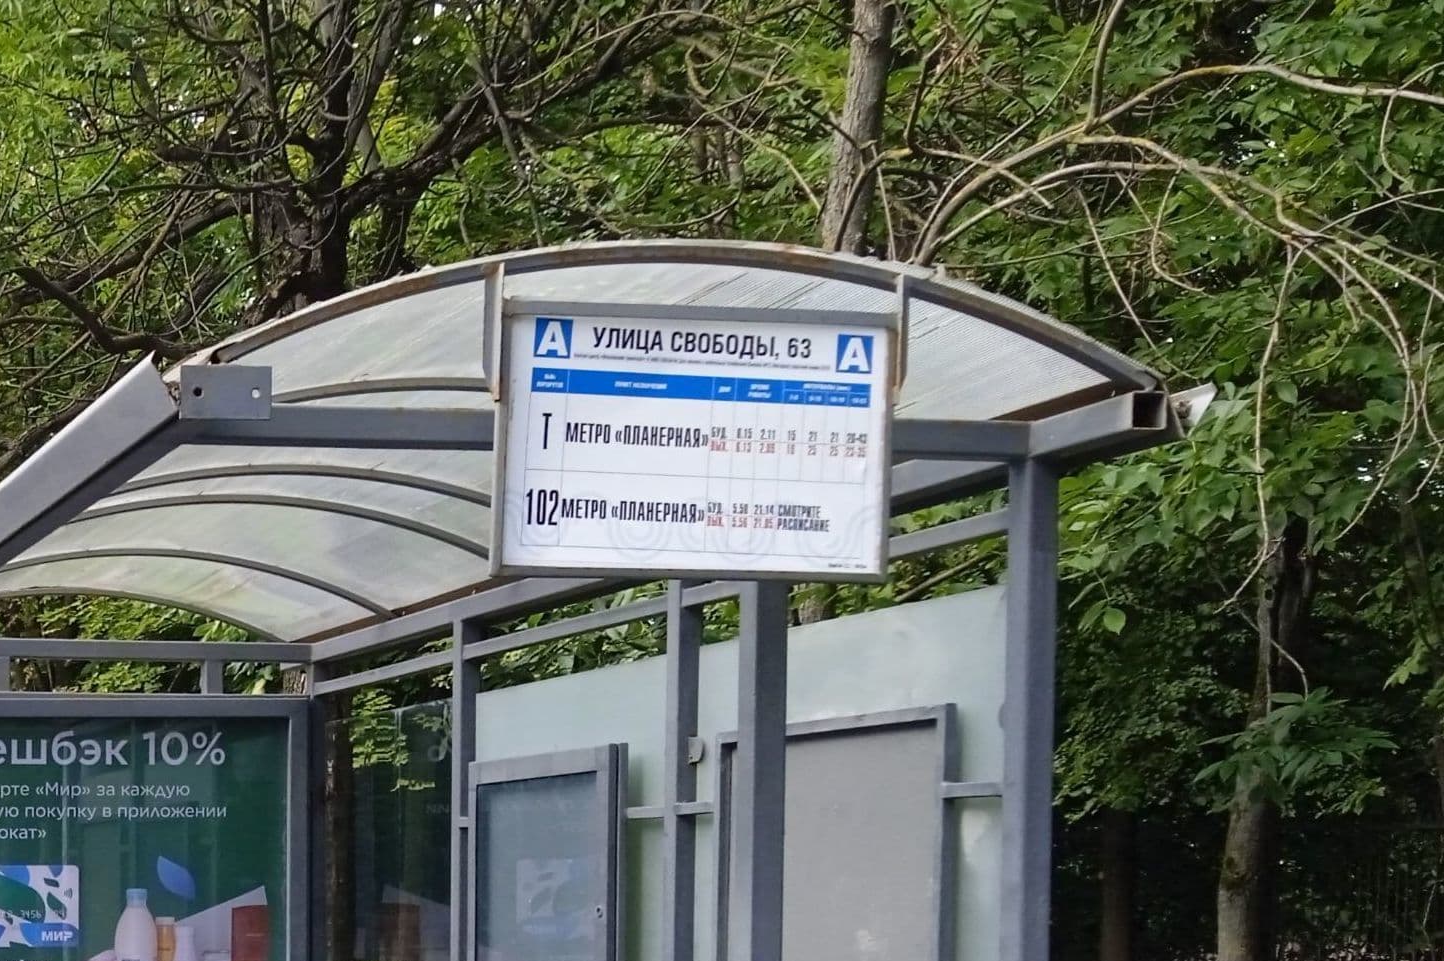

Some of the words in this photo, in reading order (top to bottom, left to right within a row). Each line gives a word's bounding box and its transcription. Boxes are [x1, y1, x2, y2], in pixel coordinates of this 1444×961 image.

[593, 327, 664, 354] УЛИЦА
[670, 331, 780, 360] СВОБОДЫ,
[787, 338, 812, 359] 63
[542, 413, 553, 450] Т
[565, 422, 611, 444] МЕТРО
[615, 425, 709, 448] «ПЛАНЕРНАЯ»
[526, 488, 559, 526] 102
[561, 498, 607, 519] МЕТРО
[611, 501, 705, 524] «ПЛАНЕРНАЯ»
[142, 731, 226, 766] 10%
[35, 781, 91, 799] «Мир»
[96, 784, 115, 796] за
[121, 784, 190, 799] каждую
[25, 806, 96, 821] покупку
[102, 806, 112, 818] в
[117, 805, 227, 820] приложении
[41, 930, 74, 942] МИР
